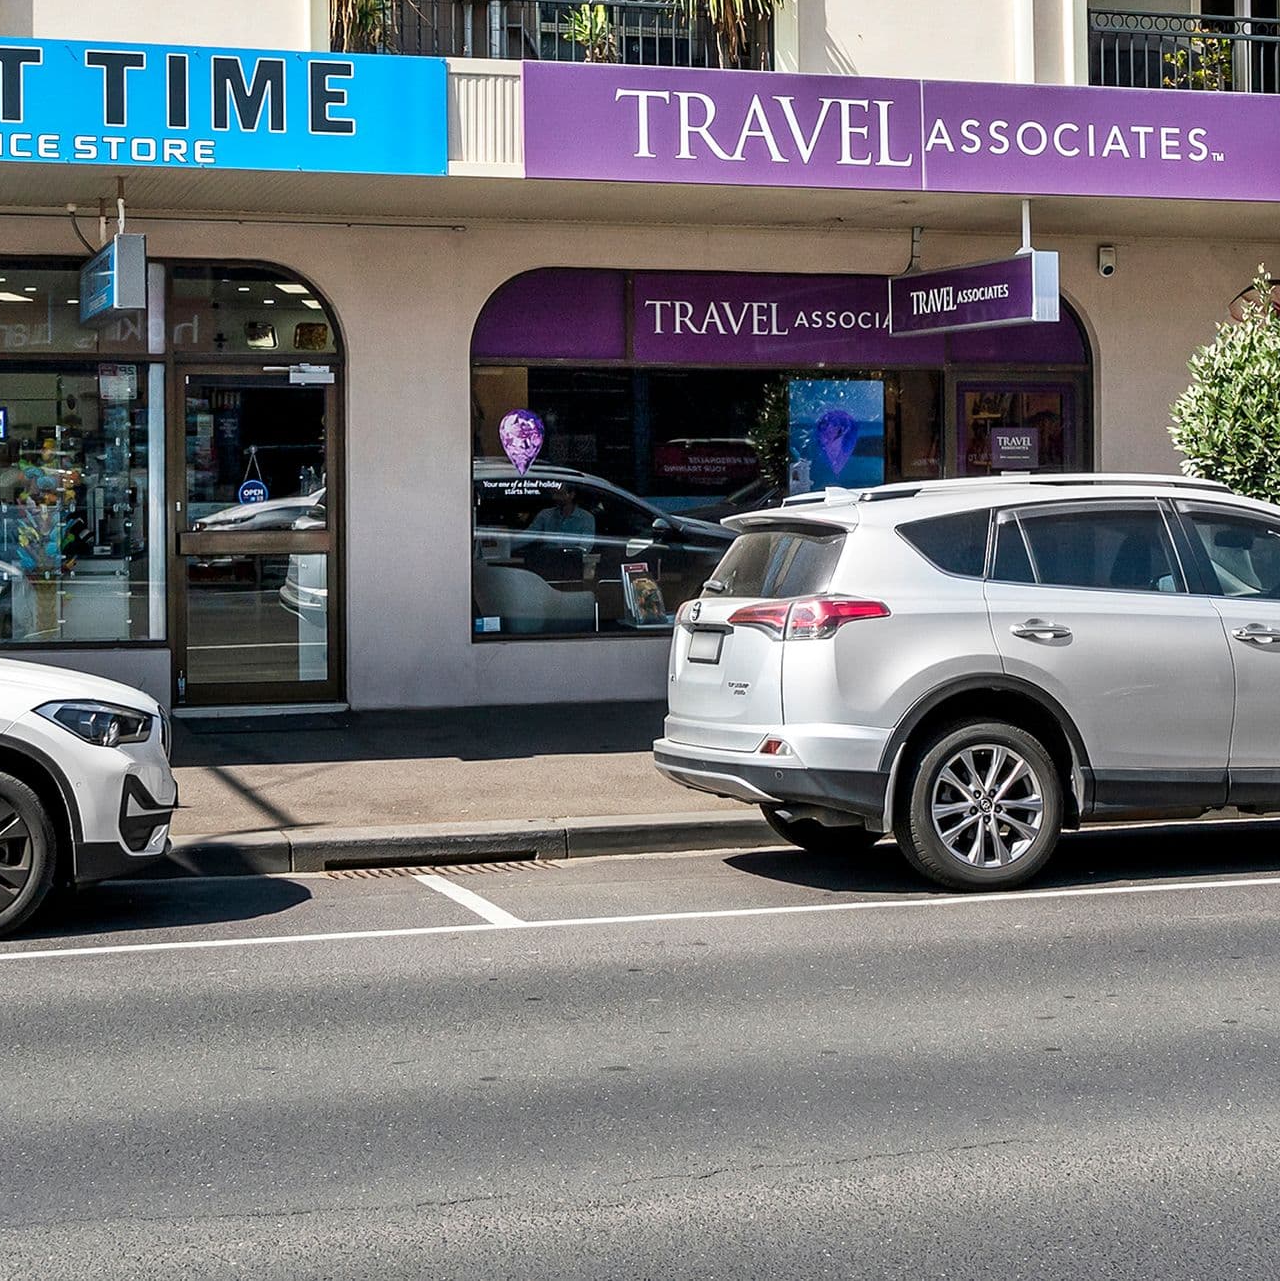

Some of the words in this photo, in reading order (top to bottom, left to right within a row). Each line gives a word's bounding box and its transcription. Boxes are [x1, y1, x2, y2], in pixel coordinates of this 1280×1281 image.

[85, 50, 355, 135] TIME
[615, 87, 913, 167] TRAVEL
[925, 118, 1209, 163] ASSOCIATES
[74, 135, 216, 163] STORE
[910, 287, 956, 315] TRAVEL
[956, 284, 1009, 304] ASSOCIATES
[645, 300, 789, 336] TRAVEL
[996, 436, 1032, 446] TRAVEL
[482, 480, 498, 488] Your
[539, 481, 562, 489] holiday
